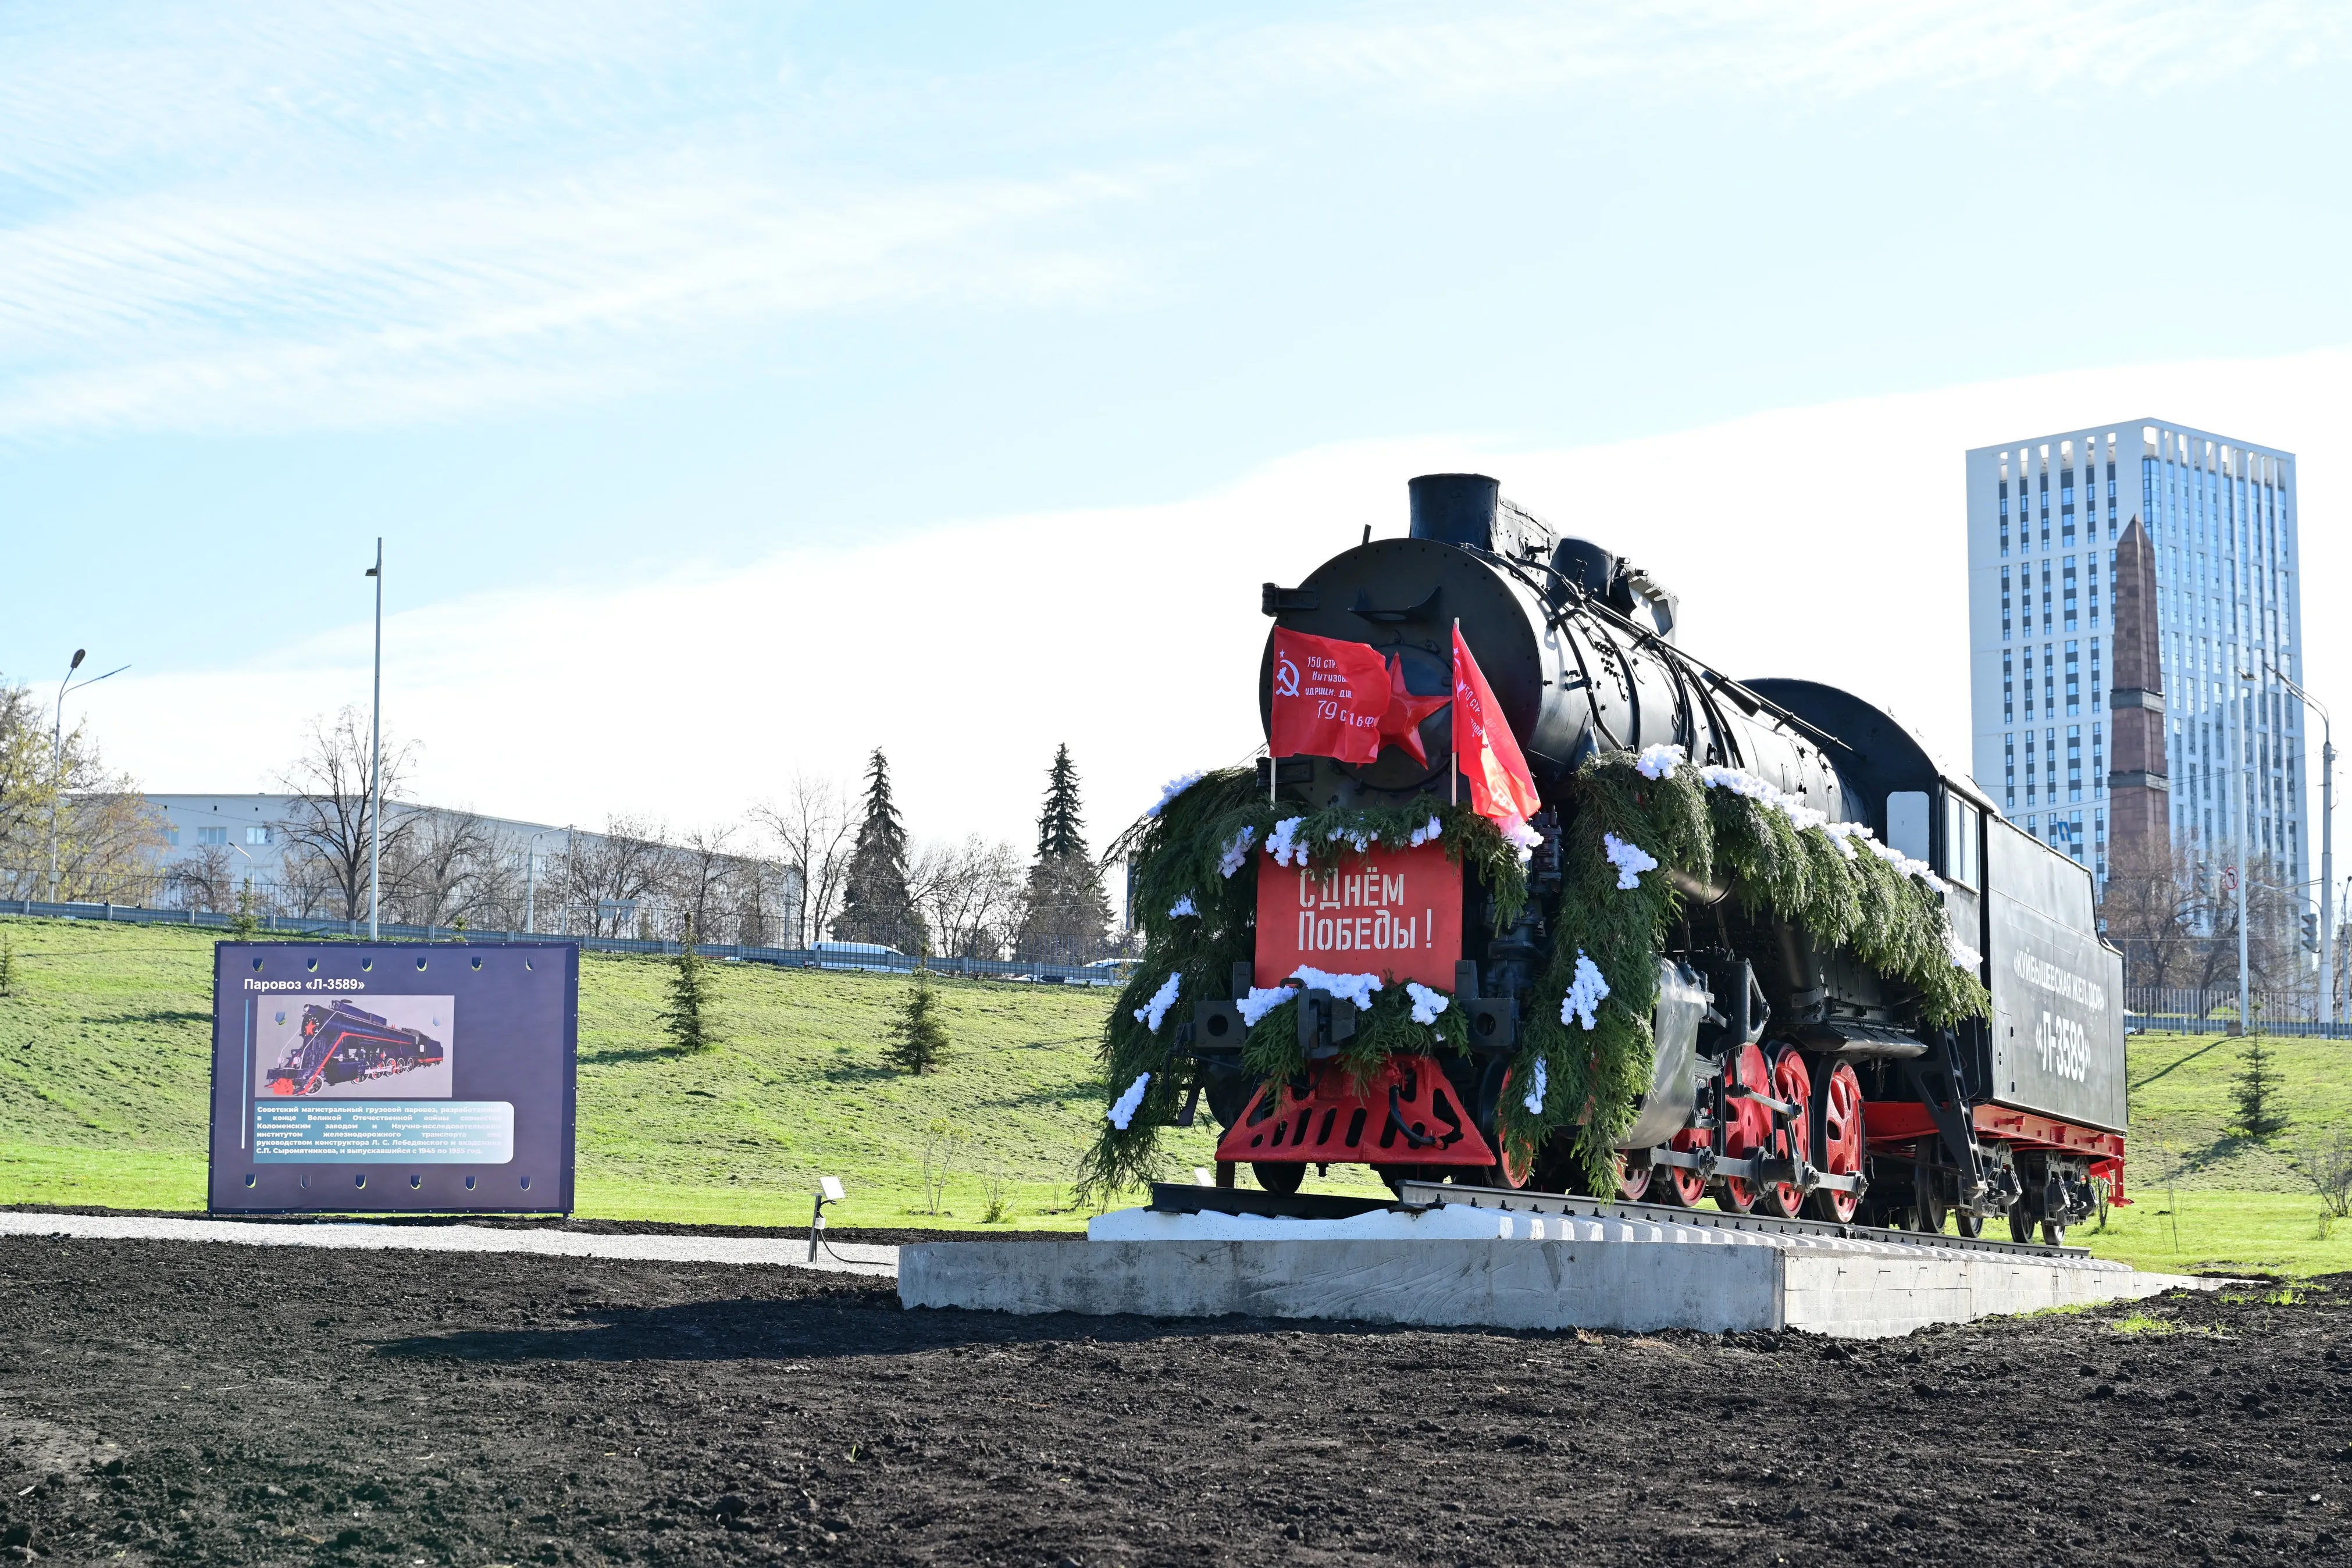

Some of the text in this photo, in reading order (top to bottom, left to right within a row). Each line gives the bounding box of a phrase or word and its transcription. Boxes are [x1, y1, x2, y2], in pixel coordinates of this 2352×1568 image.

[1307, 657, 1321, 668] 150
[1317, 700, 1338, 719] 79
[2014, 946, 2071, 999] «КУЙБЫШЕВСКАЯ
[244, 978, 365, 992] Паровоз «Л-3589»
[2036, 1010, 2091, 1082] «Л-3589»
